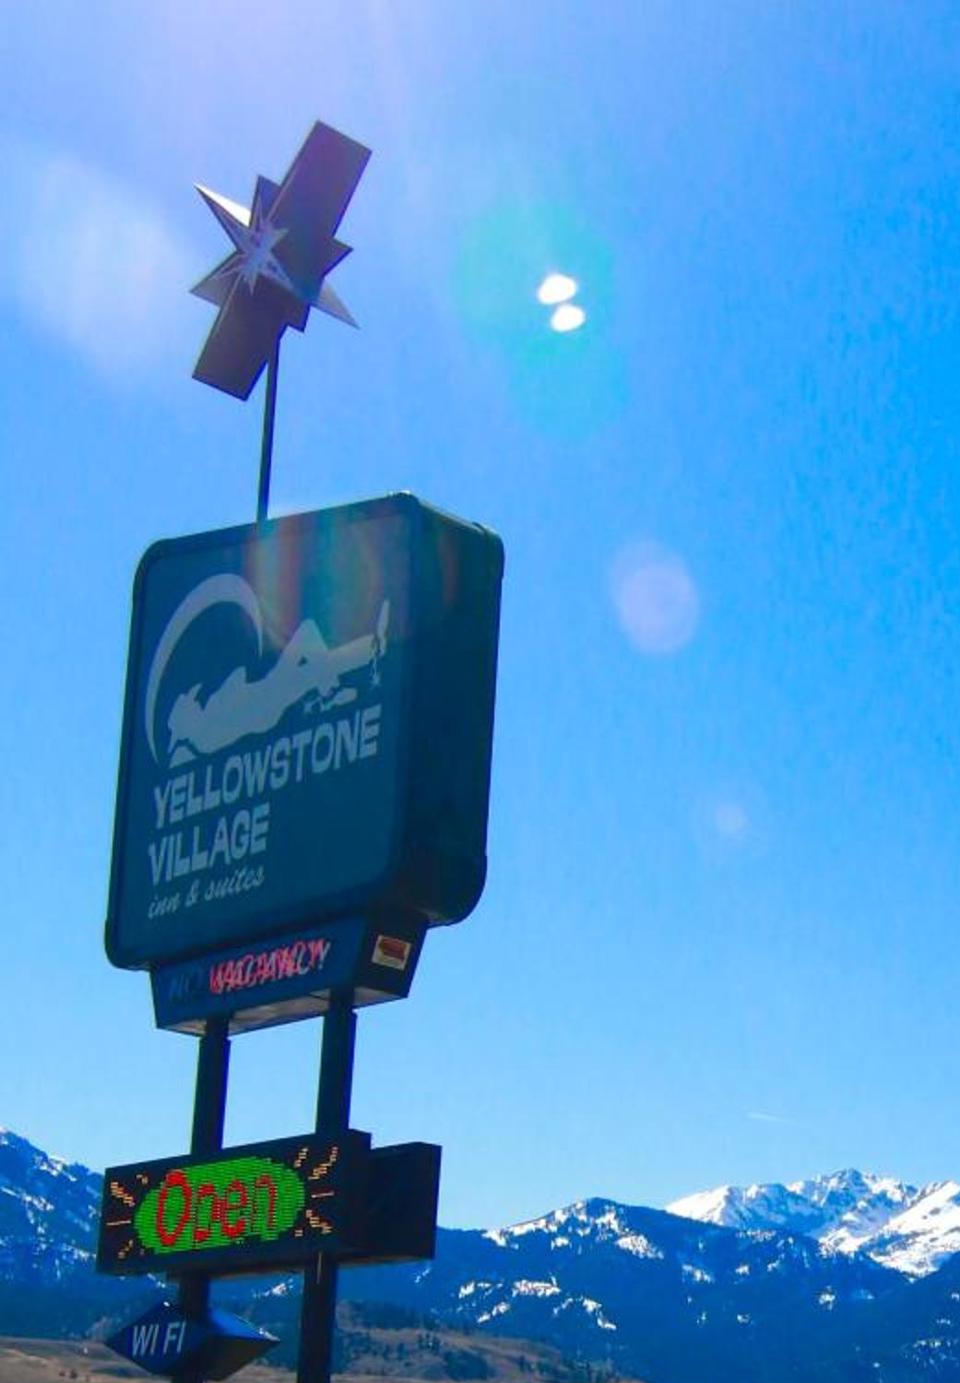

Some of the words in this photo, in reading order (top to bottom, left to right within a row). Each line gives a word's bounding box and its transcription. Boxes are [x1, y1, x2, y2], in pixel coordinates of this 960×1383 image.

[154, 703, 382, 829] YELLOWSTONE
[148, 802, 270, 886] VILLAGE
[148, 893, 181, 919] inn
[186, 880, 201, 907] &
[204, 866, 265, 901] suites
[209, 938, 332, 995] VACANCY
[156, 1169, 278, 1249] Open
[132, 1324, 159, 1357] WI
[163, 1320, 187, 1354] FI
